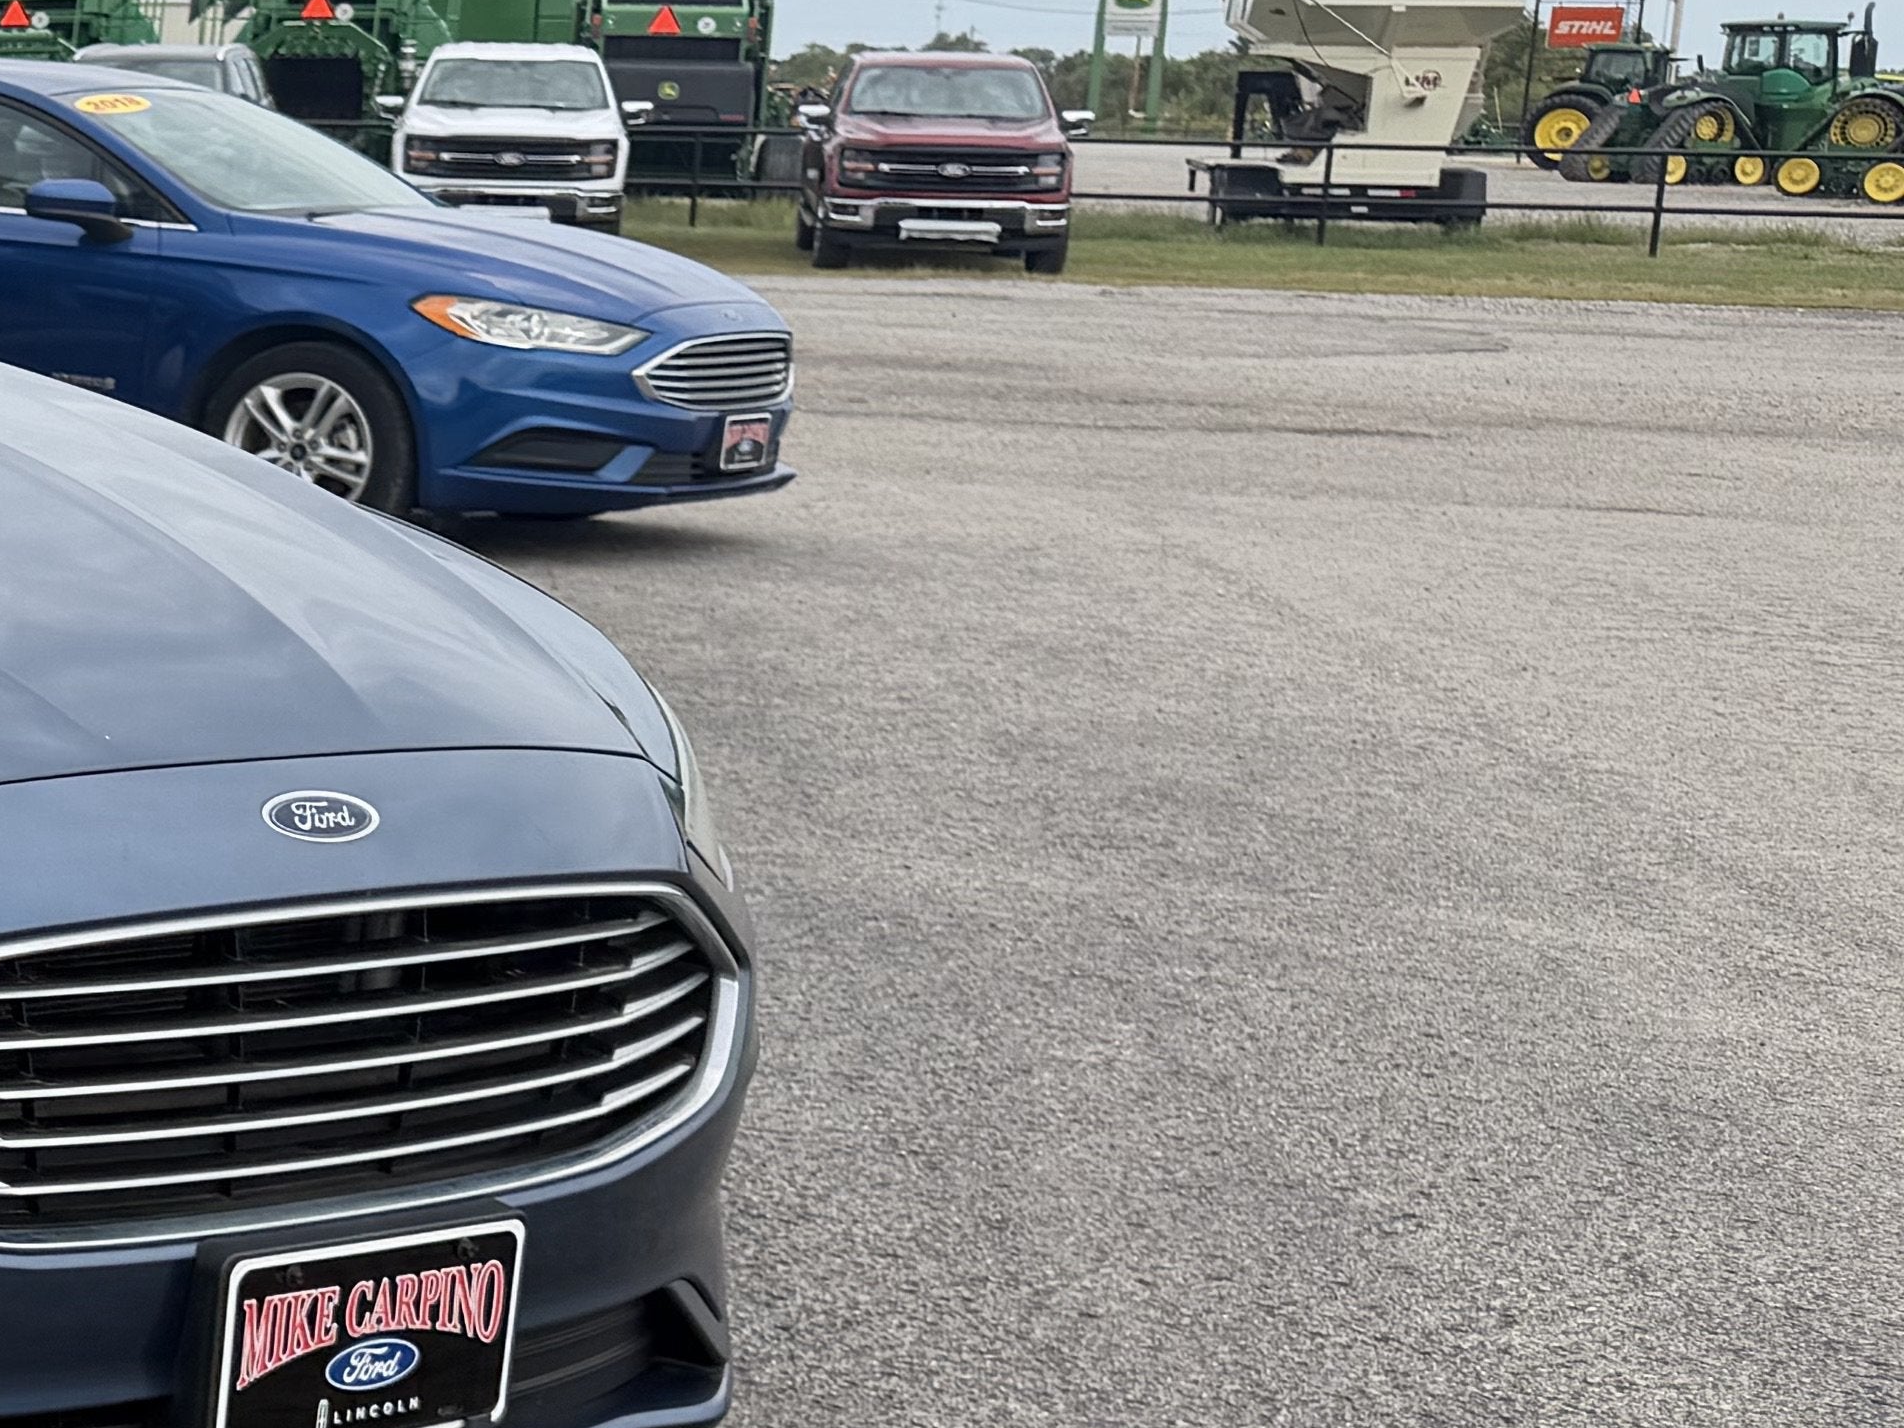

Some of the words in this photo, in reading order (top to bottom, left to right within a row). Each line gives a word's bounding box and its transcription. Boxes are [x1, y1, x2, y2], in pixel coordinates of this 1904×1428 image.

[1554, 19, 1617, 35] STIHL
[290, 801, 356, 831] Ford
[236, 1285, 341, 1391] MIKE
[345, 1259, 505, 1343] CARPINO
[342, 1345, 401, 1383] Ford
[333, 1395, 420, 1424] LINCOLN
